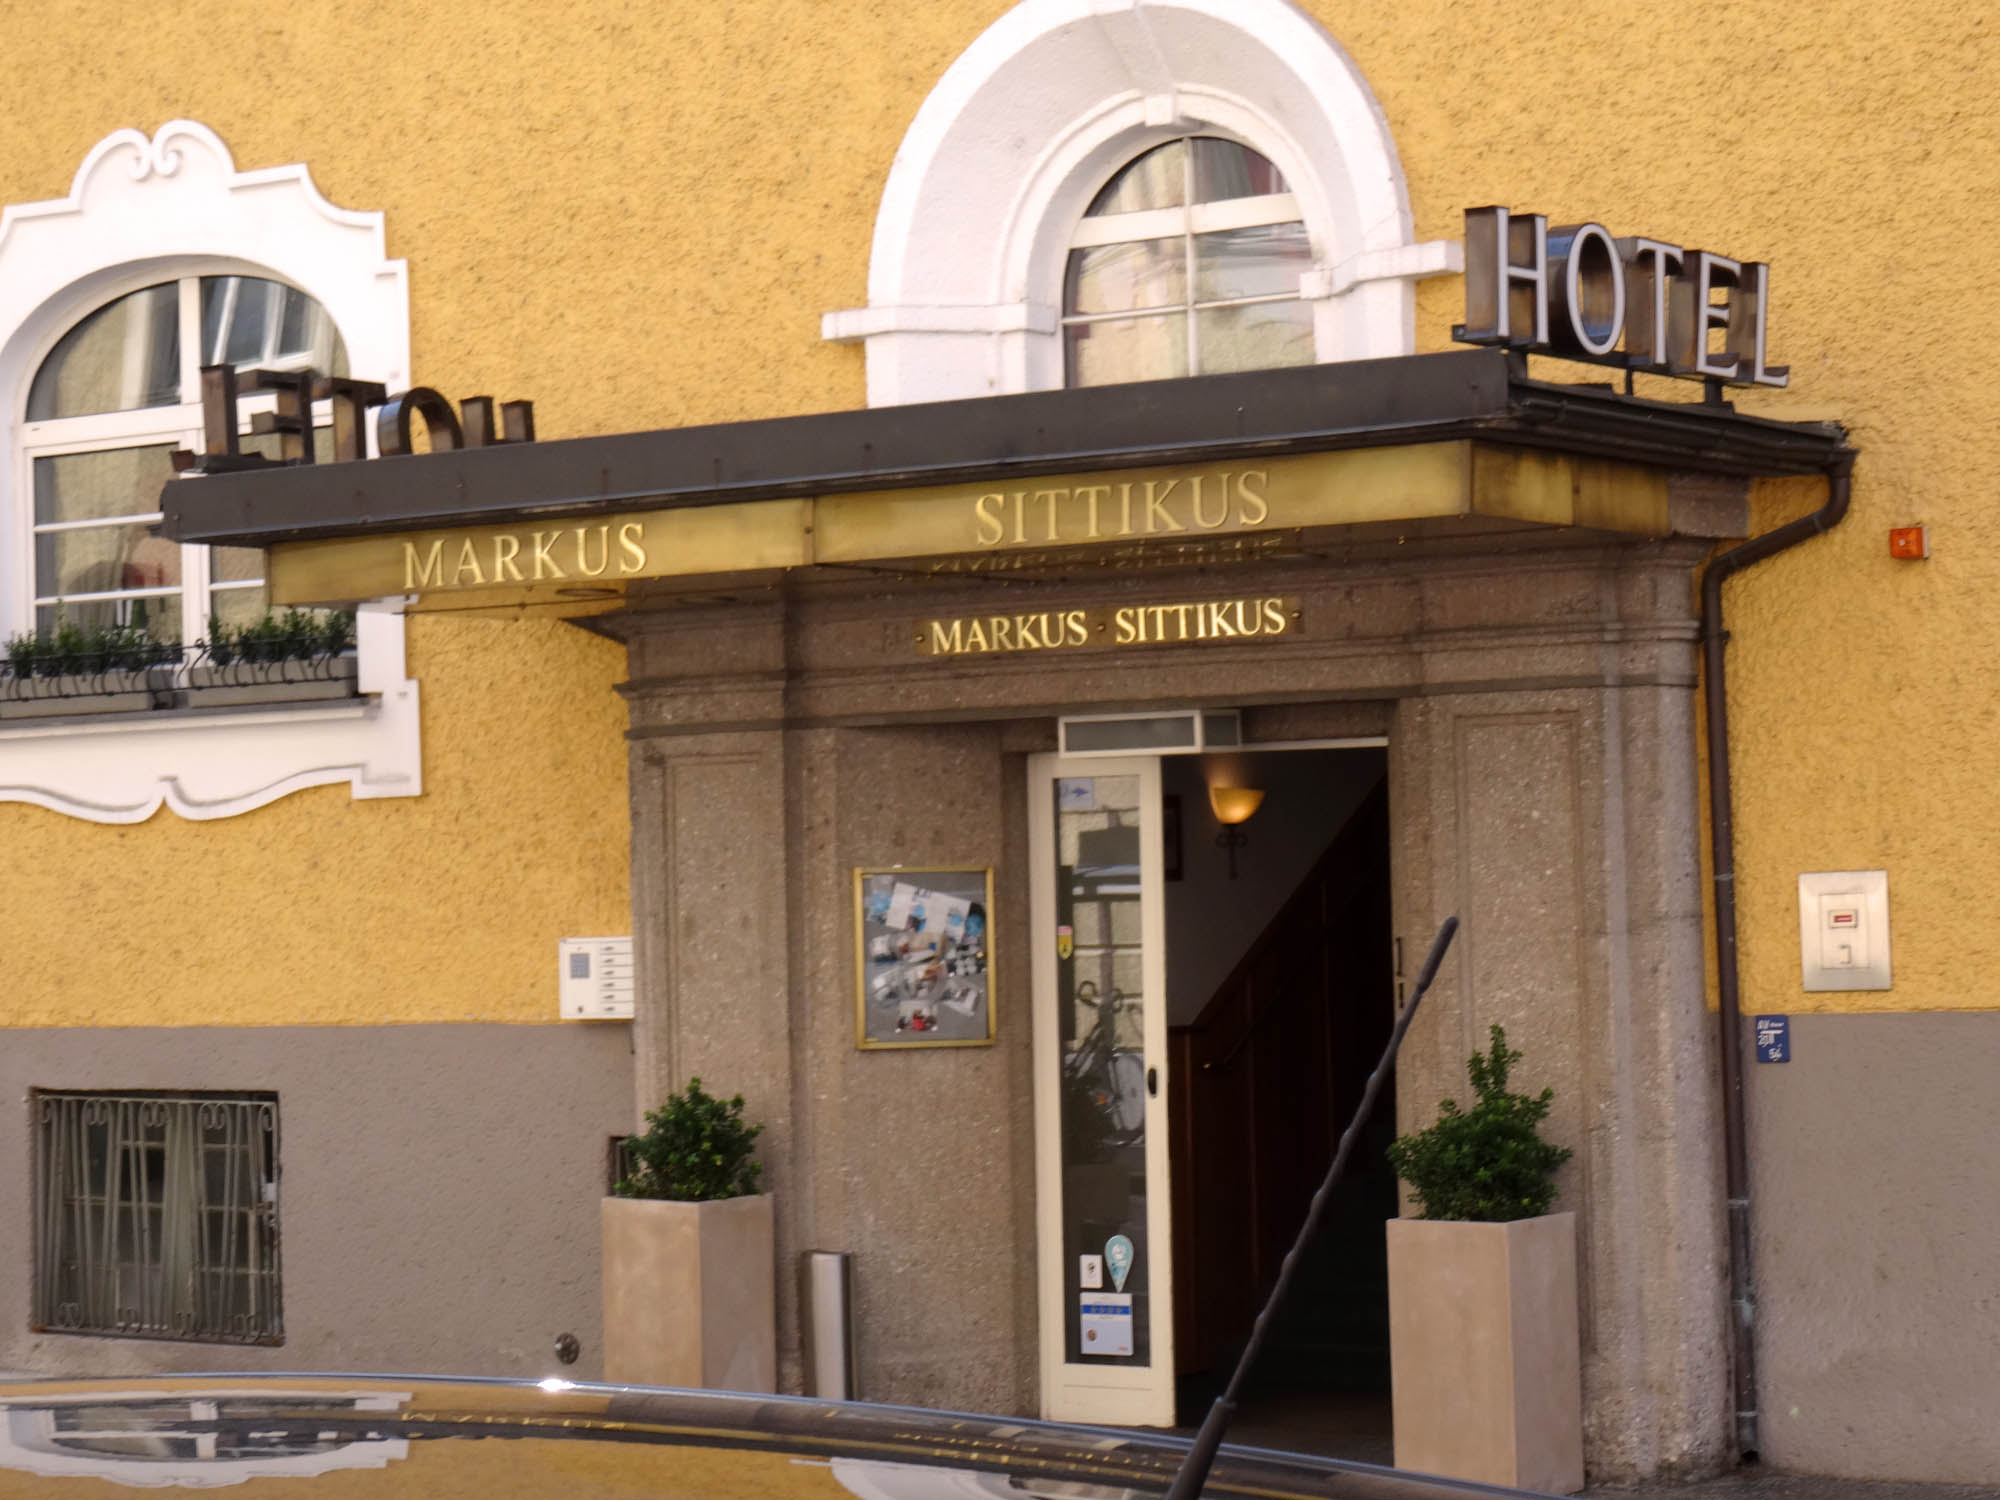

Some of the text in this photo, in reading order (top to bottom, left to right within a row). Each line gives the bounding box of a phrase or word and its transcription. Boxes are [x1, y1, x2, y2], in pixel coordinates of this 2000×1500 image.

[1496, 205, 1790, 388] HOTEL
[403, 469, 1270, 590] MARKUS SITTIKUS
[930, 597, 1286, 656] MARKUS SITTIKUS
